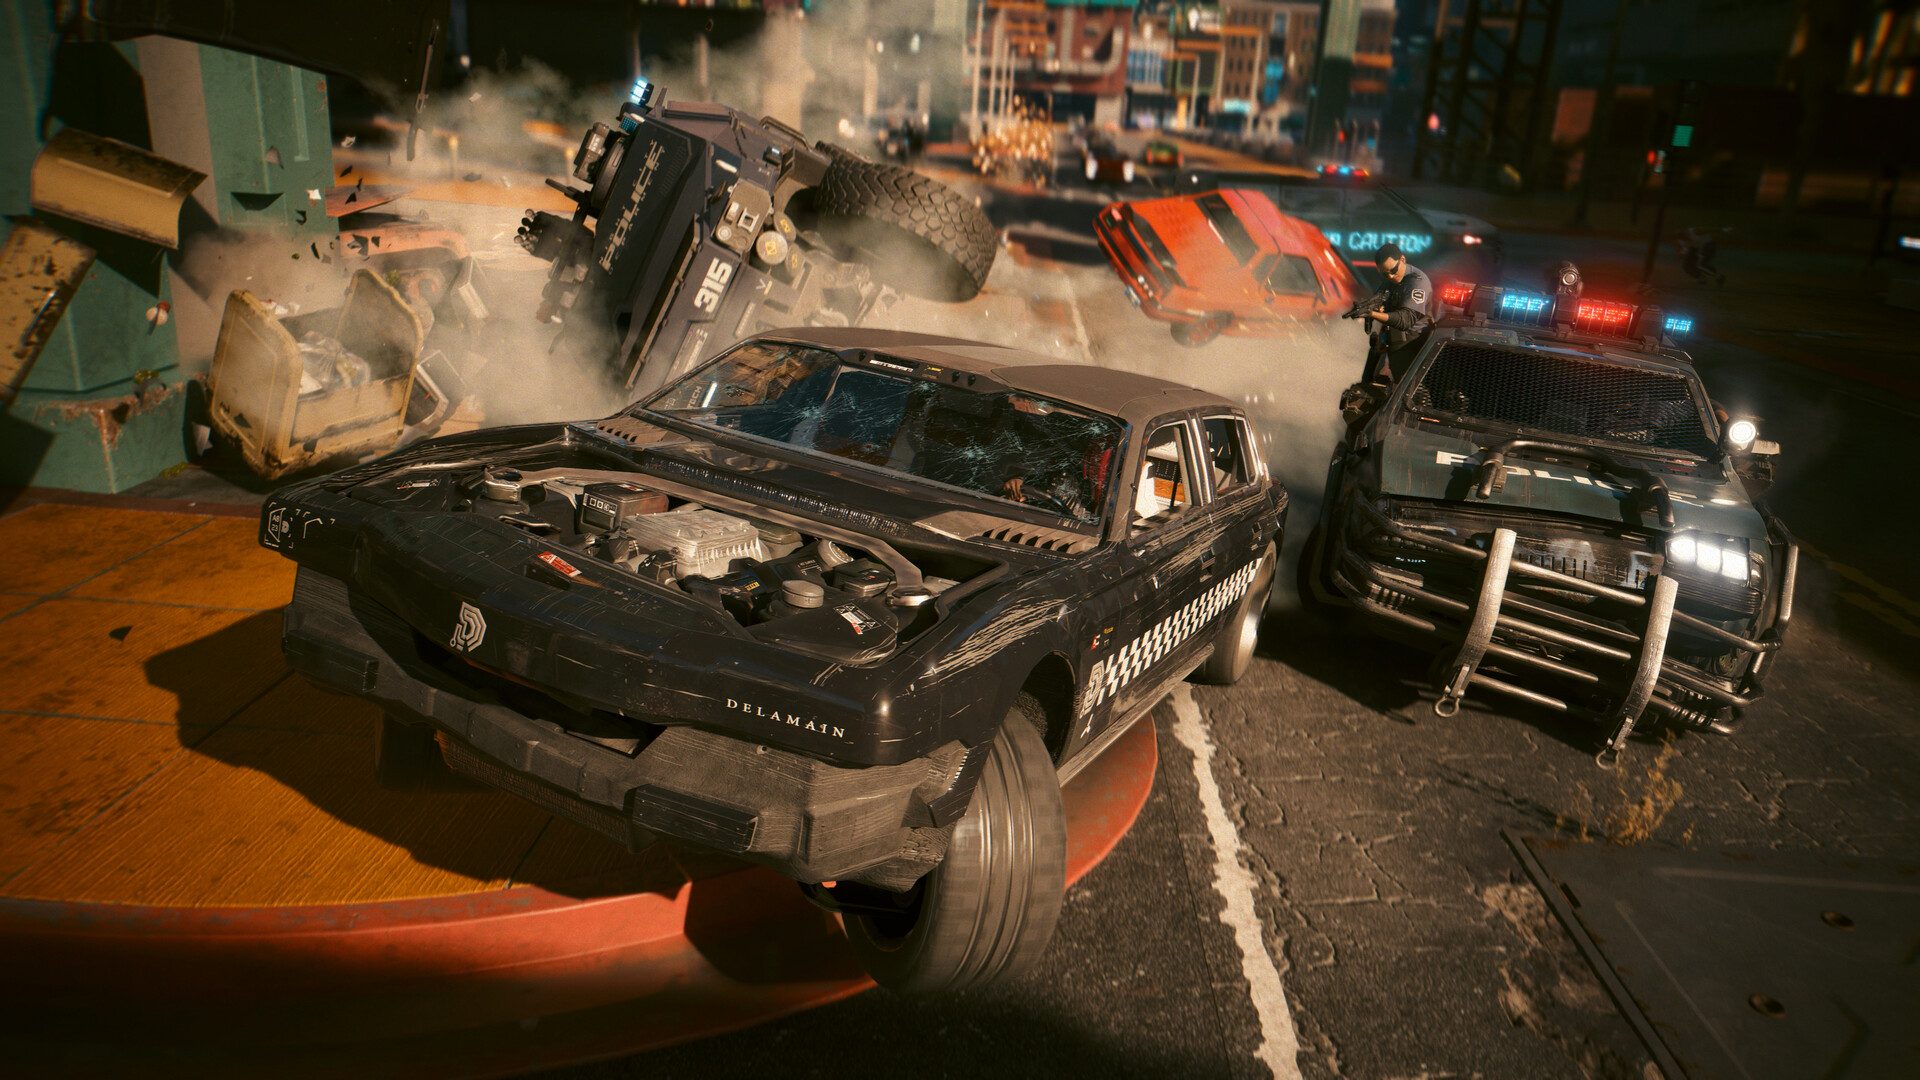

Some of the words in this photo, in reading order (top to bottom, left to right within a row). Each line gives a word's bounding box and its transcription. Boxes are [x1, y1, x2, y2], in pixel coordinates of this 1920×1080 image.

[632, 139, 655, 188] CITY
[601, 140, 663, 272] POLICE
[1349, 231, 1433, 254] CAUTION
[693, 257, 733, 313] 315
[726, 698, 846, 739] DELAMAIN
